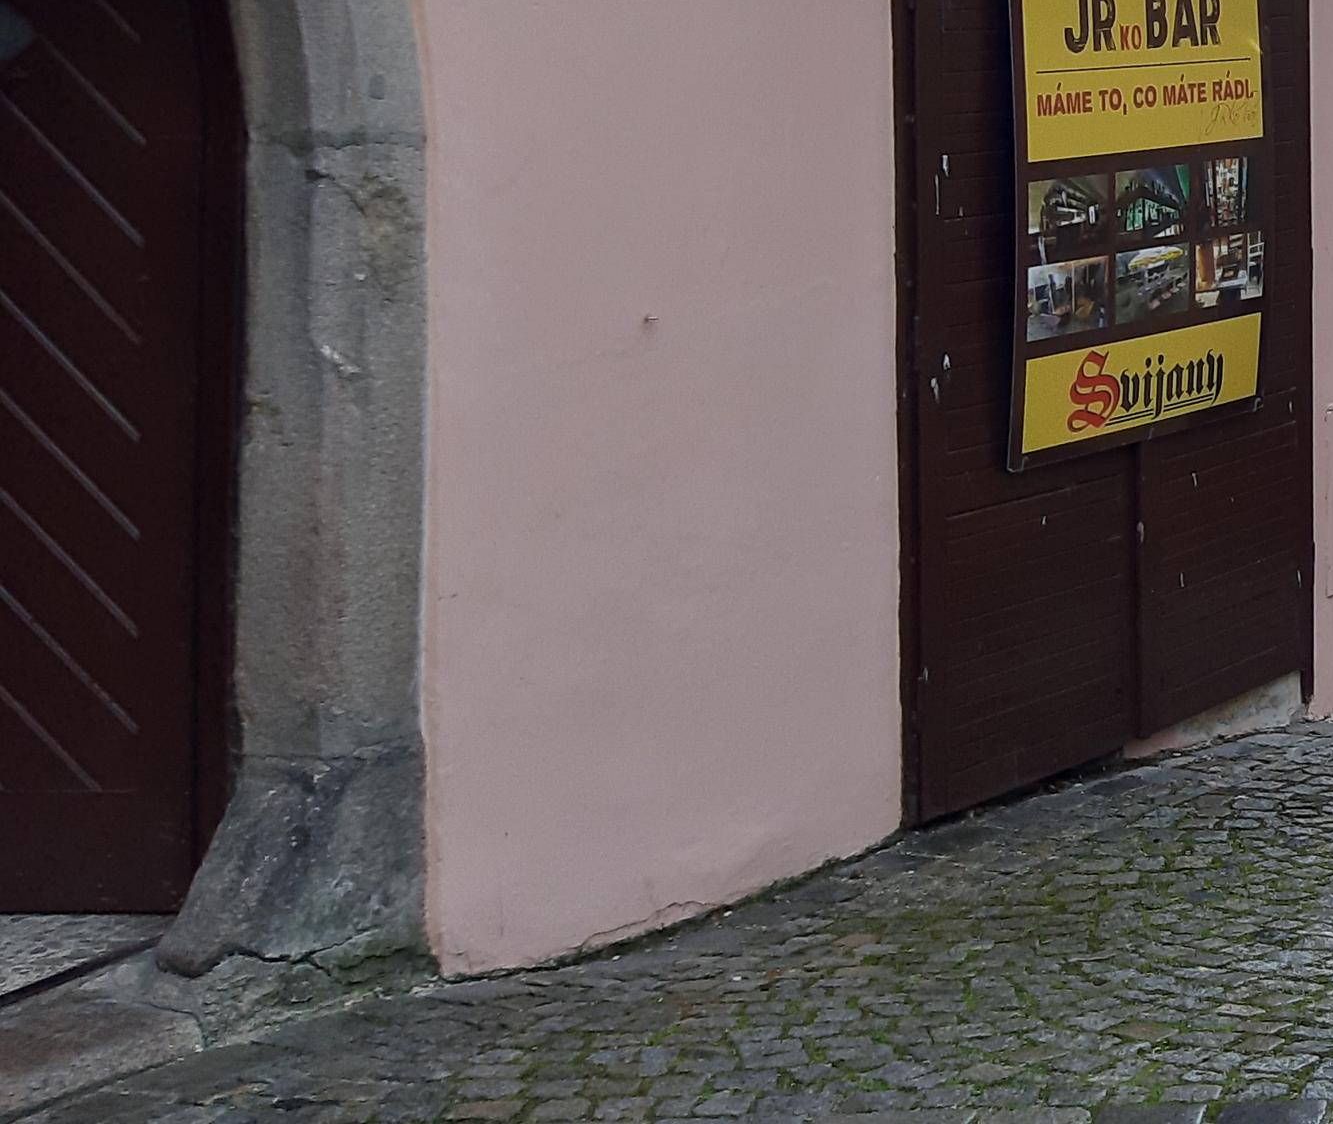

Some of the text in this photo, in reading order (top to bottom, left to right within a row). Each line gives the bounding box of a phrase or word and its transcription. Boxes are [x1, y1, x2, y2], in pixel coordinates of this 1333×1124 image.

[1036, 82, 1093, 117] MÁME
[1099, 88, 1128, 116] TO,
[1132, 85, 1157, 109] CO
[1162, 73, 1207, 106] MÁTE
[1067, 348, 1224, 433] Svijany
